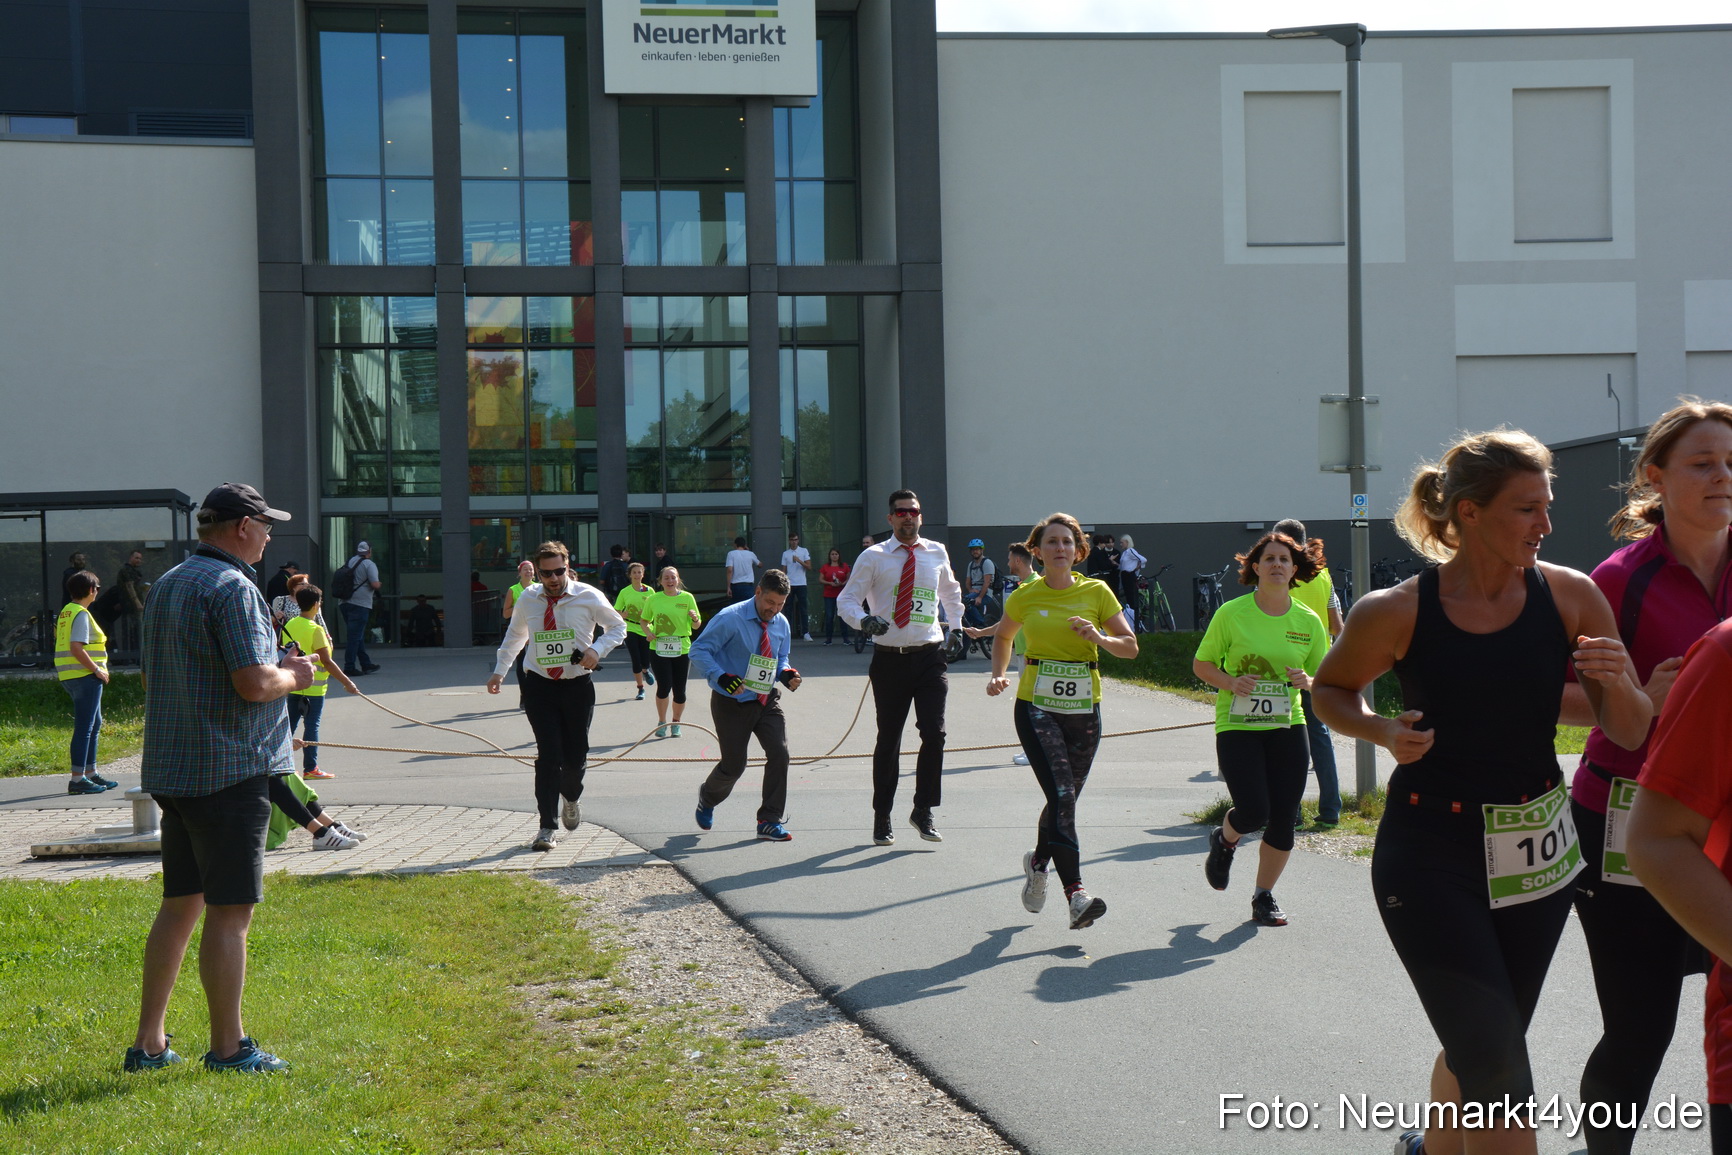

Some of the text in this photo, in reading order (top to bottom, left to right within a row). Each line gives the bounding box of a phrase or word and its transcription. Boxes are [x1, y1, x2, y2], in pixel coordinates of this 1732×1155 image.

[633, 22, 787, 45] NeuerMarkt
[641, 51, 780, 63] einkaufen leben genießen
[909, 614, 925, 622] ARIO
[537, 630, 571, 642] BOCK
[546, 643, 563, 655] 90
[758, 670, 772, 682] 91
[1042, 662, 1089, 677] BOCK
[1053, 680, 1077, 697] 68
[1251, 683, 1285, 696] OCK
[1043, 698, 1082, 708] RAMONA
[1250, 698, 1273, 714] 70
[1516, 818, 1567, 867] 101
[1521, 859, 1571, 890] SONJA
